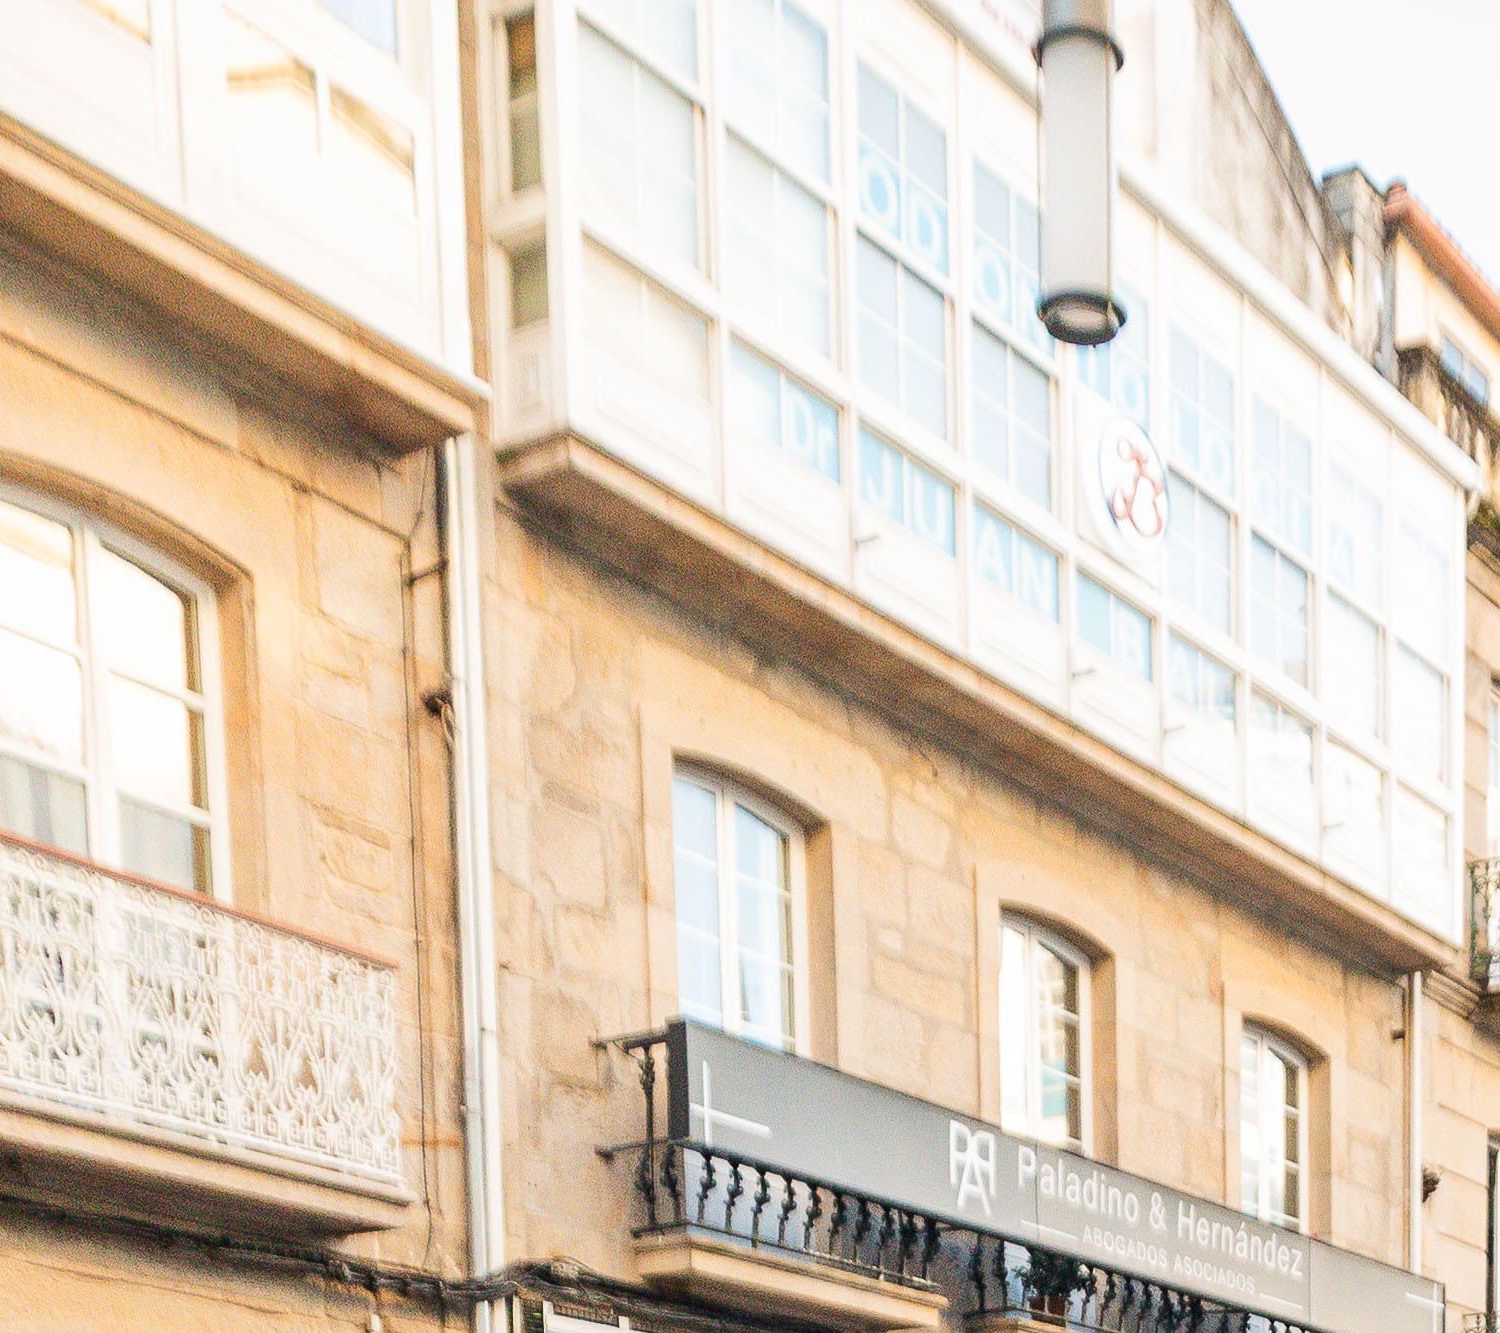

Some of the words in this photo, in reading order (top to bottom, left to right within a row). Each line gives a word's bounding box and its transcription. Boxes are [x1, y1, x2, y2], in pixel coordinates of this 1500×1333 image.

[1018, 1145, 1139, 1222] Paladino
[1149, 1191, 1168, 1232] &
[1177, 1200, 1305, 1277] Hernández
[1082, 1223, 1169, 1268] ABOGADOS
[1173, 1252, 1257, 1295] ASOCIADOS
